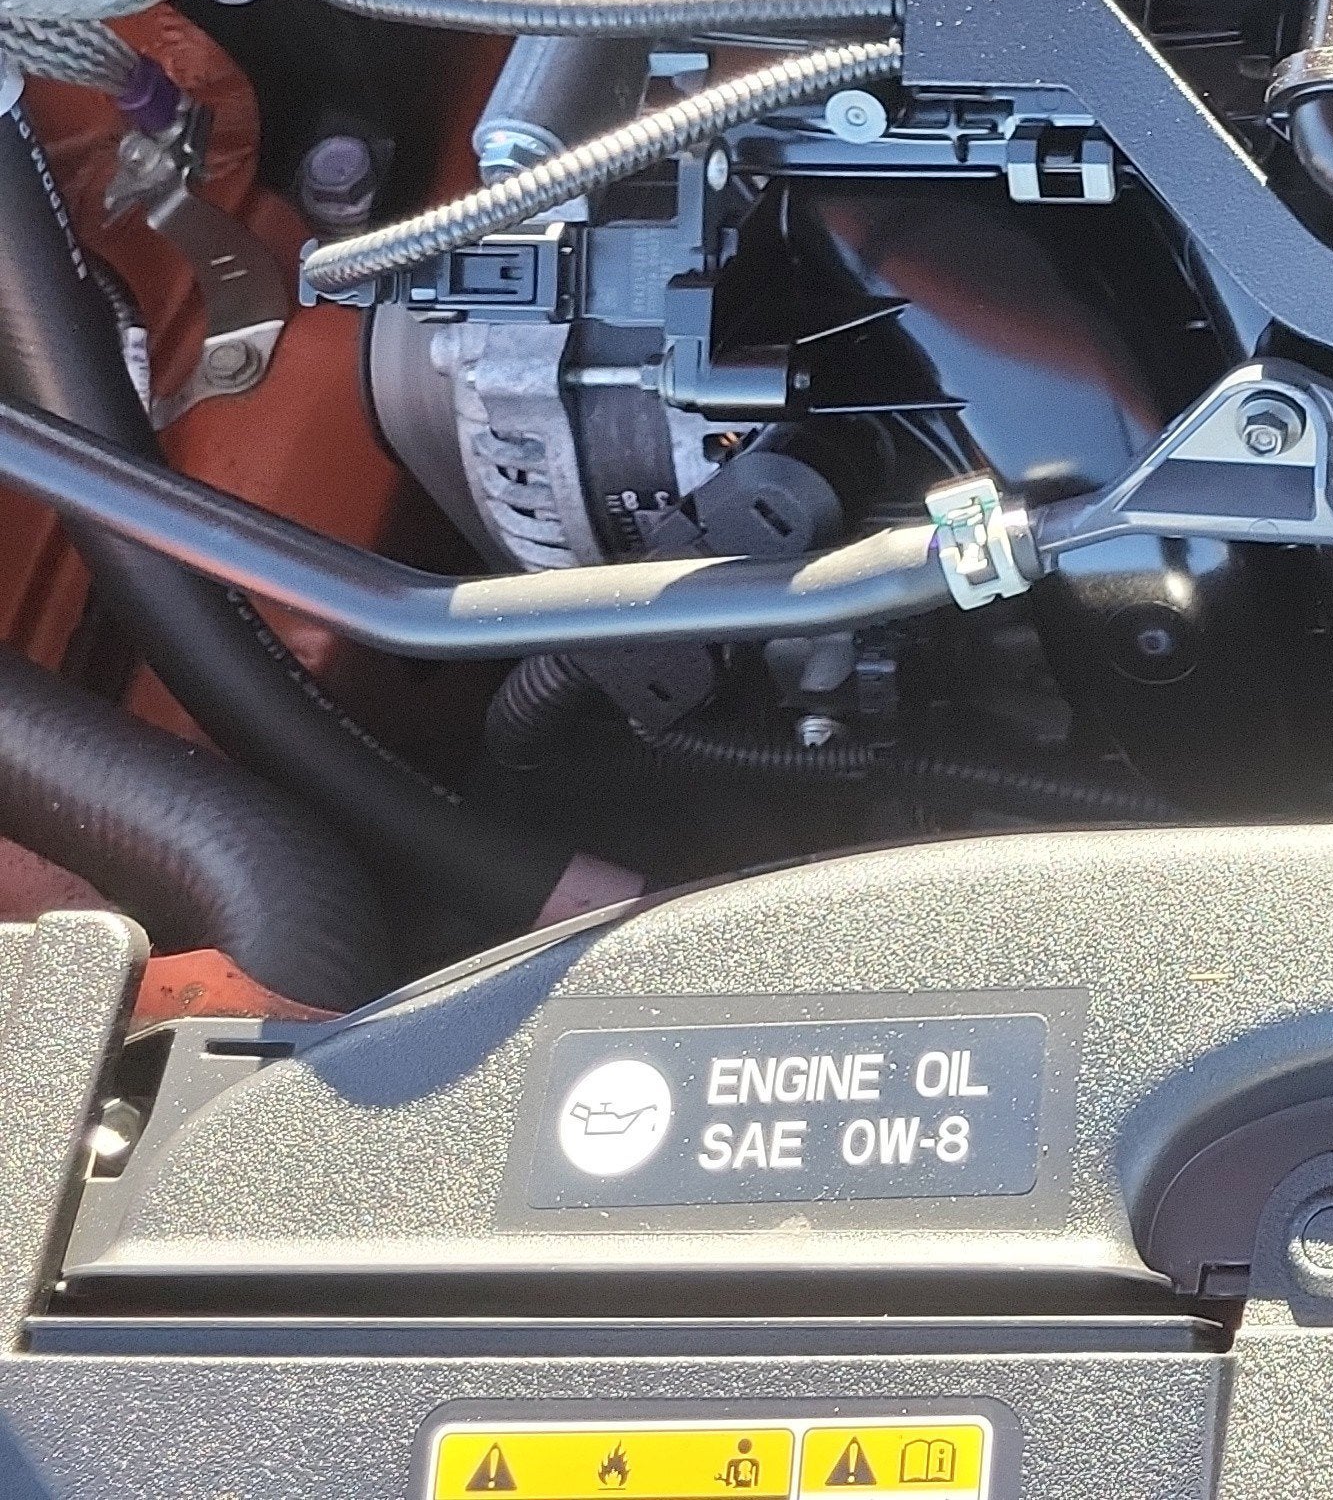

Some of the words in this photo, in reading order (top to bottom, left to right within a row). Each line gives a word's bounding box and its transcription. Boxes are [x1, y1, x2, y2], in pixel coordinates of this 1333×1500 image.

[706, 1053, 885, 1105] ENGINE
[915, 1049, 989, 1098] OIL
[699, 1119, 808, 1170] SAE
[841, 1115, 970, 1166] 0W-8
